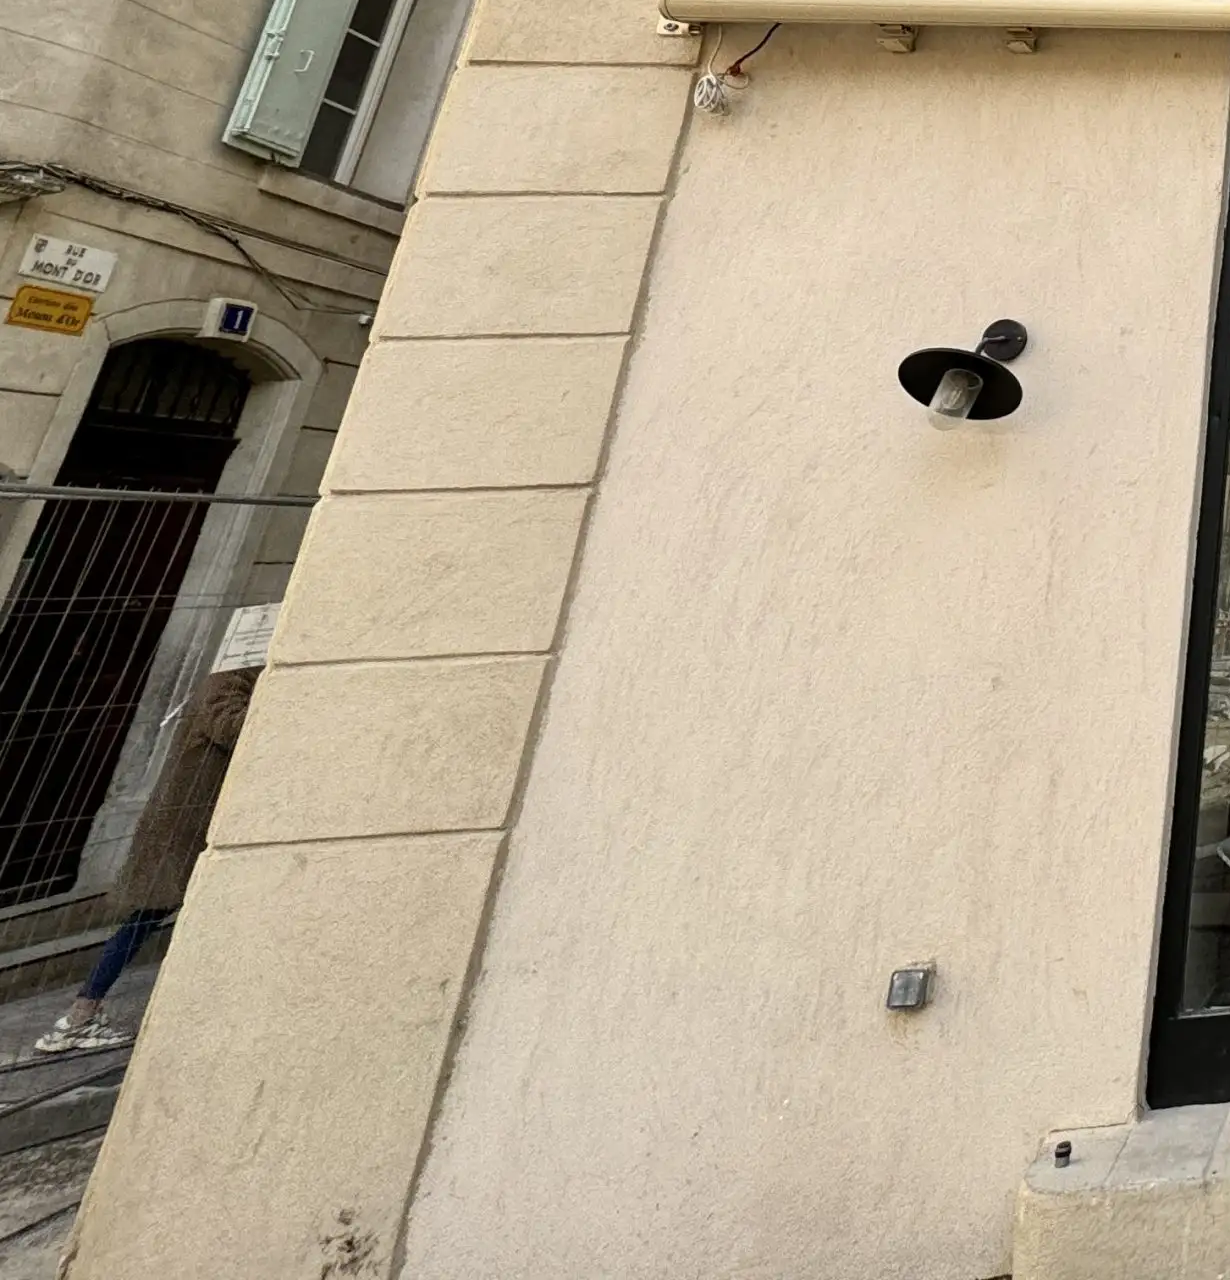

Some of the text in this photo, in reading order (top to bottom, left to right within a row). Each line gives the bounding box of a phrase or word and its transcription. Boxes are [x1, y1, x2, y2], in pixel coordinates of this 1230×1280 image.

[65, 245, 87, 258] RUE
[31, 259, 68, 279] MONT
[233, 310, 243, 328] 1
